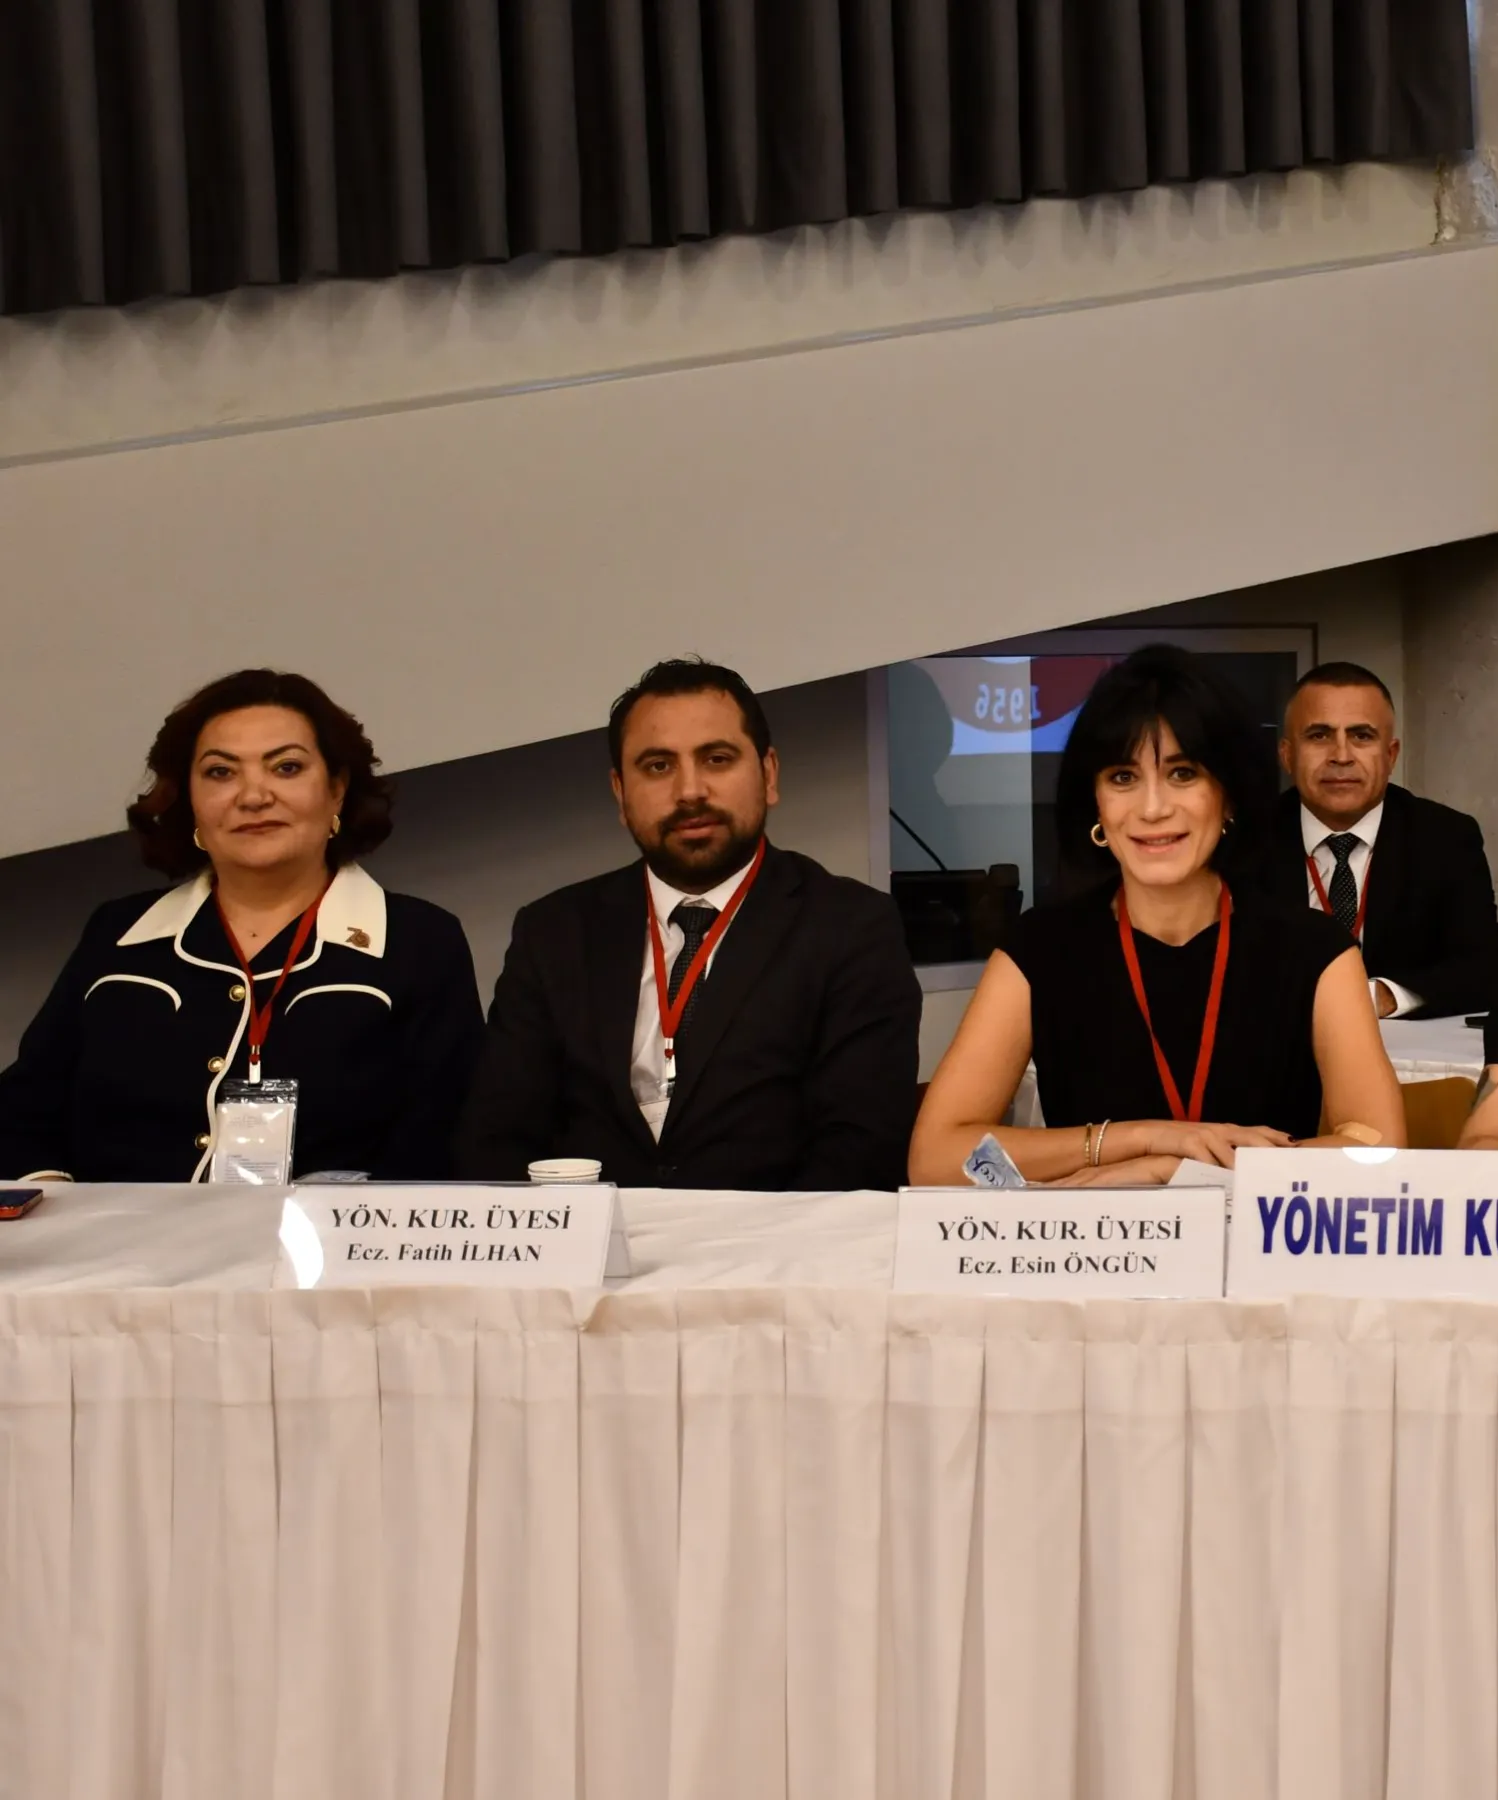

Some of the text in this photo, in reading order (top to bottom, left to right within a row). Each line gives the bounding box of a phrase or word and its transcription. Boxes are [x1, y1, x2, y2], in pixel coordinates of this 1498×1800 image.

[331, 1203, 572, 1230] YÖN. KUR. ÜYESİ
[937, 1215, 1182, 1241] YÖN. KUR. ÜYESİ
[1257, 1181, 1445, 1256] YÖNETİM
[347, 1239, 542, 1262] Ecz. Fatih İLHAN
[958, 1252, 1158, 1275] Ecz. Esin ÖNGÜN
